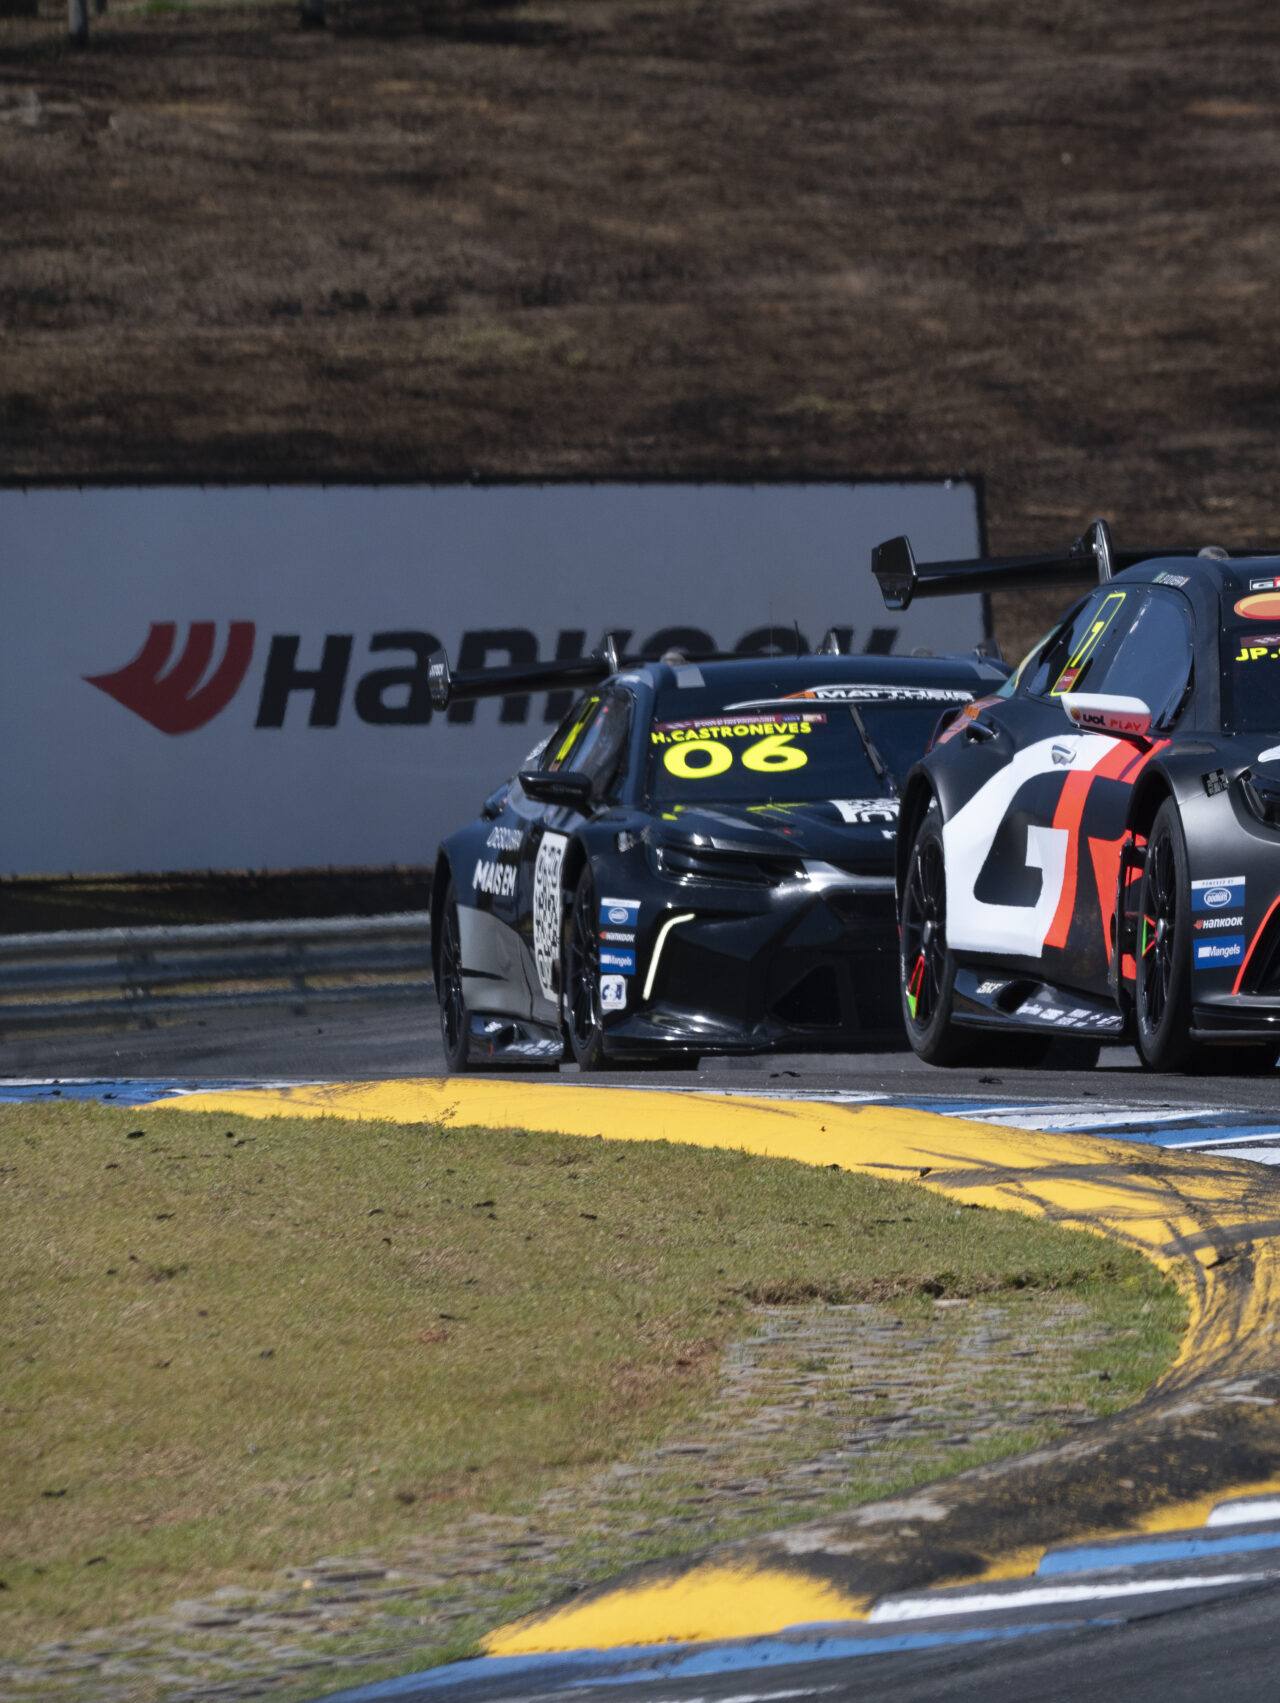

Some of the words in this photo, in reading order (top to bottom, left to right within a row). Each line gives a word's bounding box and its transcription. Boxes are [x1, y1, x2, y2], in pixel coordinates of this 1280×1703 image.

[651, 722, 812, 745] H.CASTRONEVES
[1110, 719, 1143, 731] PLAY
[663, 734, 809, 779] 06
